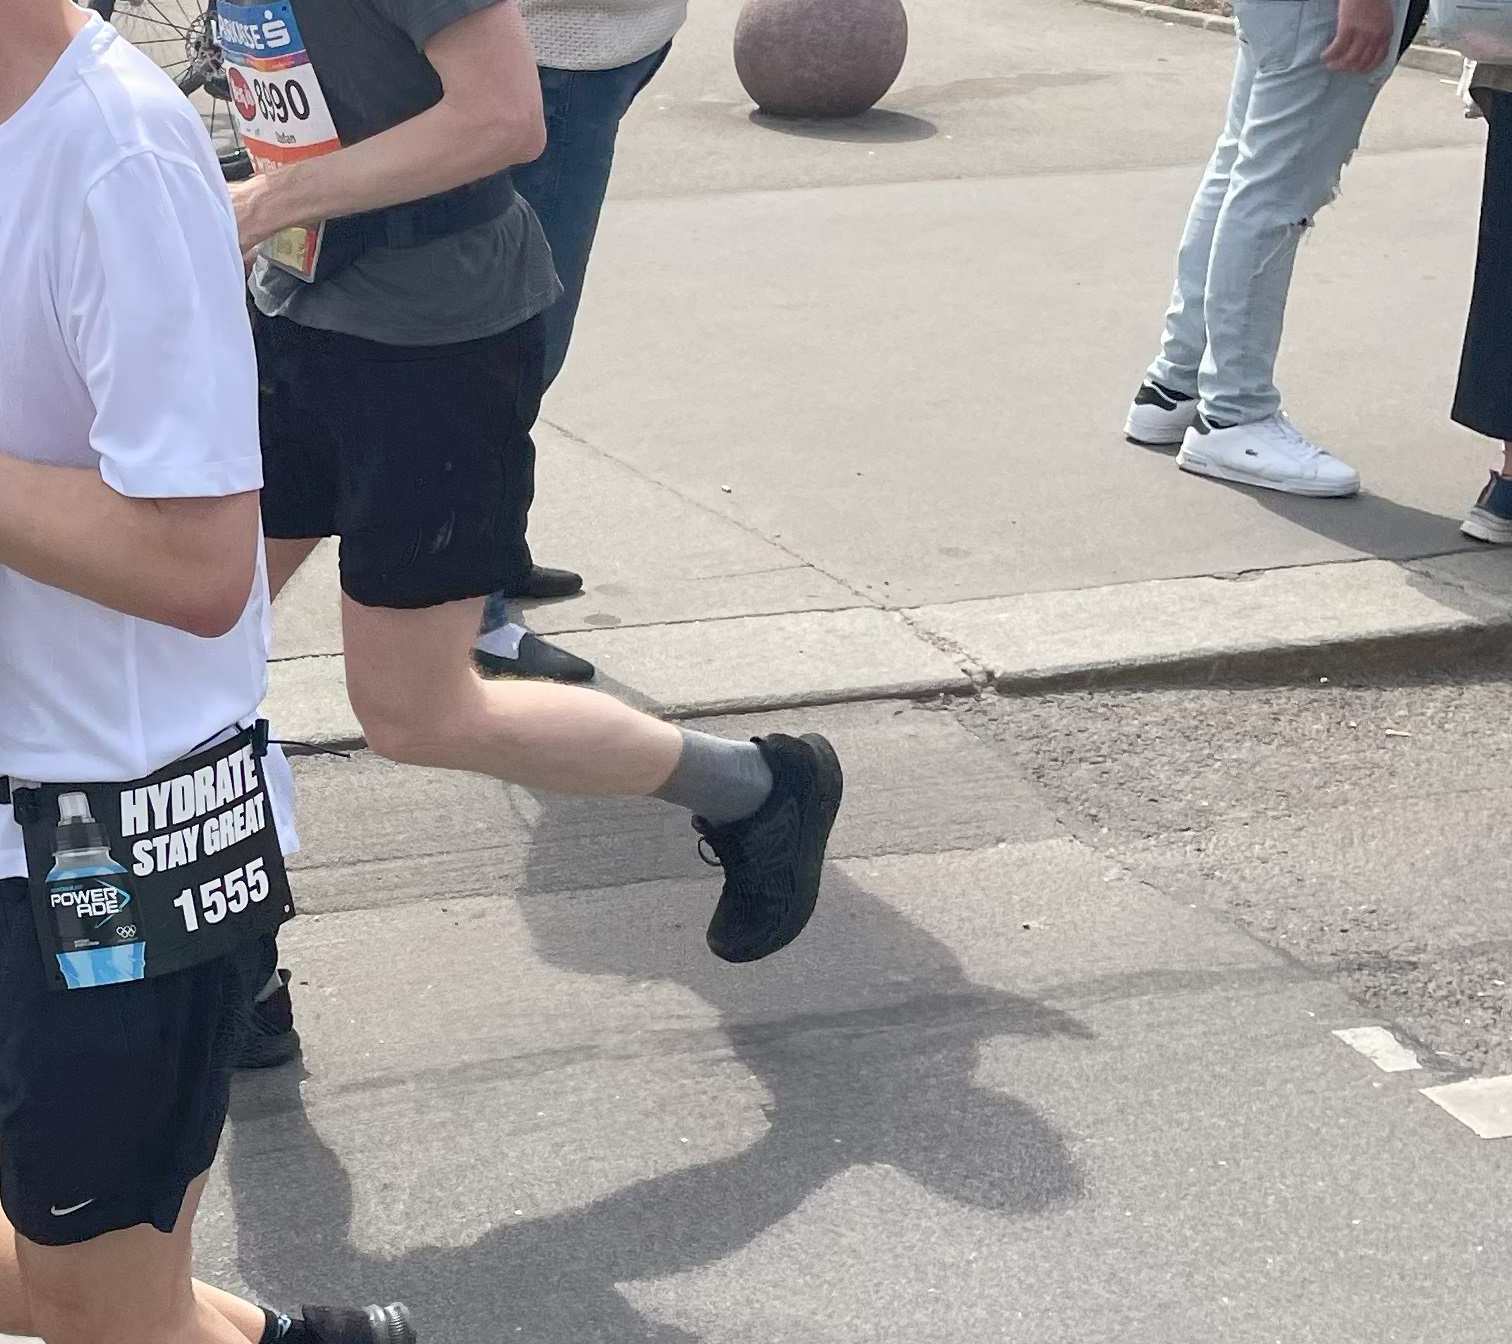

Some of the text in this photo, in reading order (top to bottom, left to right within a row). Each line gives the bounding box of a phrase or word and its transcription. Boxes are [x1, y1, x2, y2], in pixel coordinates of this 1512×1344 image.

[120, 744, 259, 838] HYDRATE
[132, 792, 266, 877] STAY GREAT
[50, 886, 118, 908] POWER
[76, 900, 120, 918] ADE
[173, 856, 270, 933] 1555
